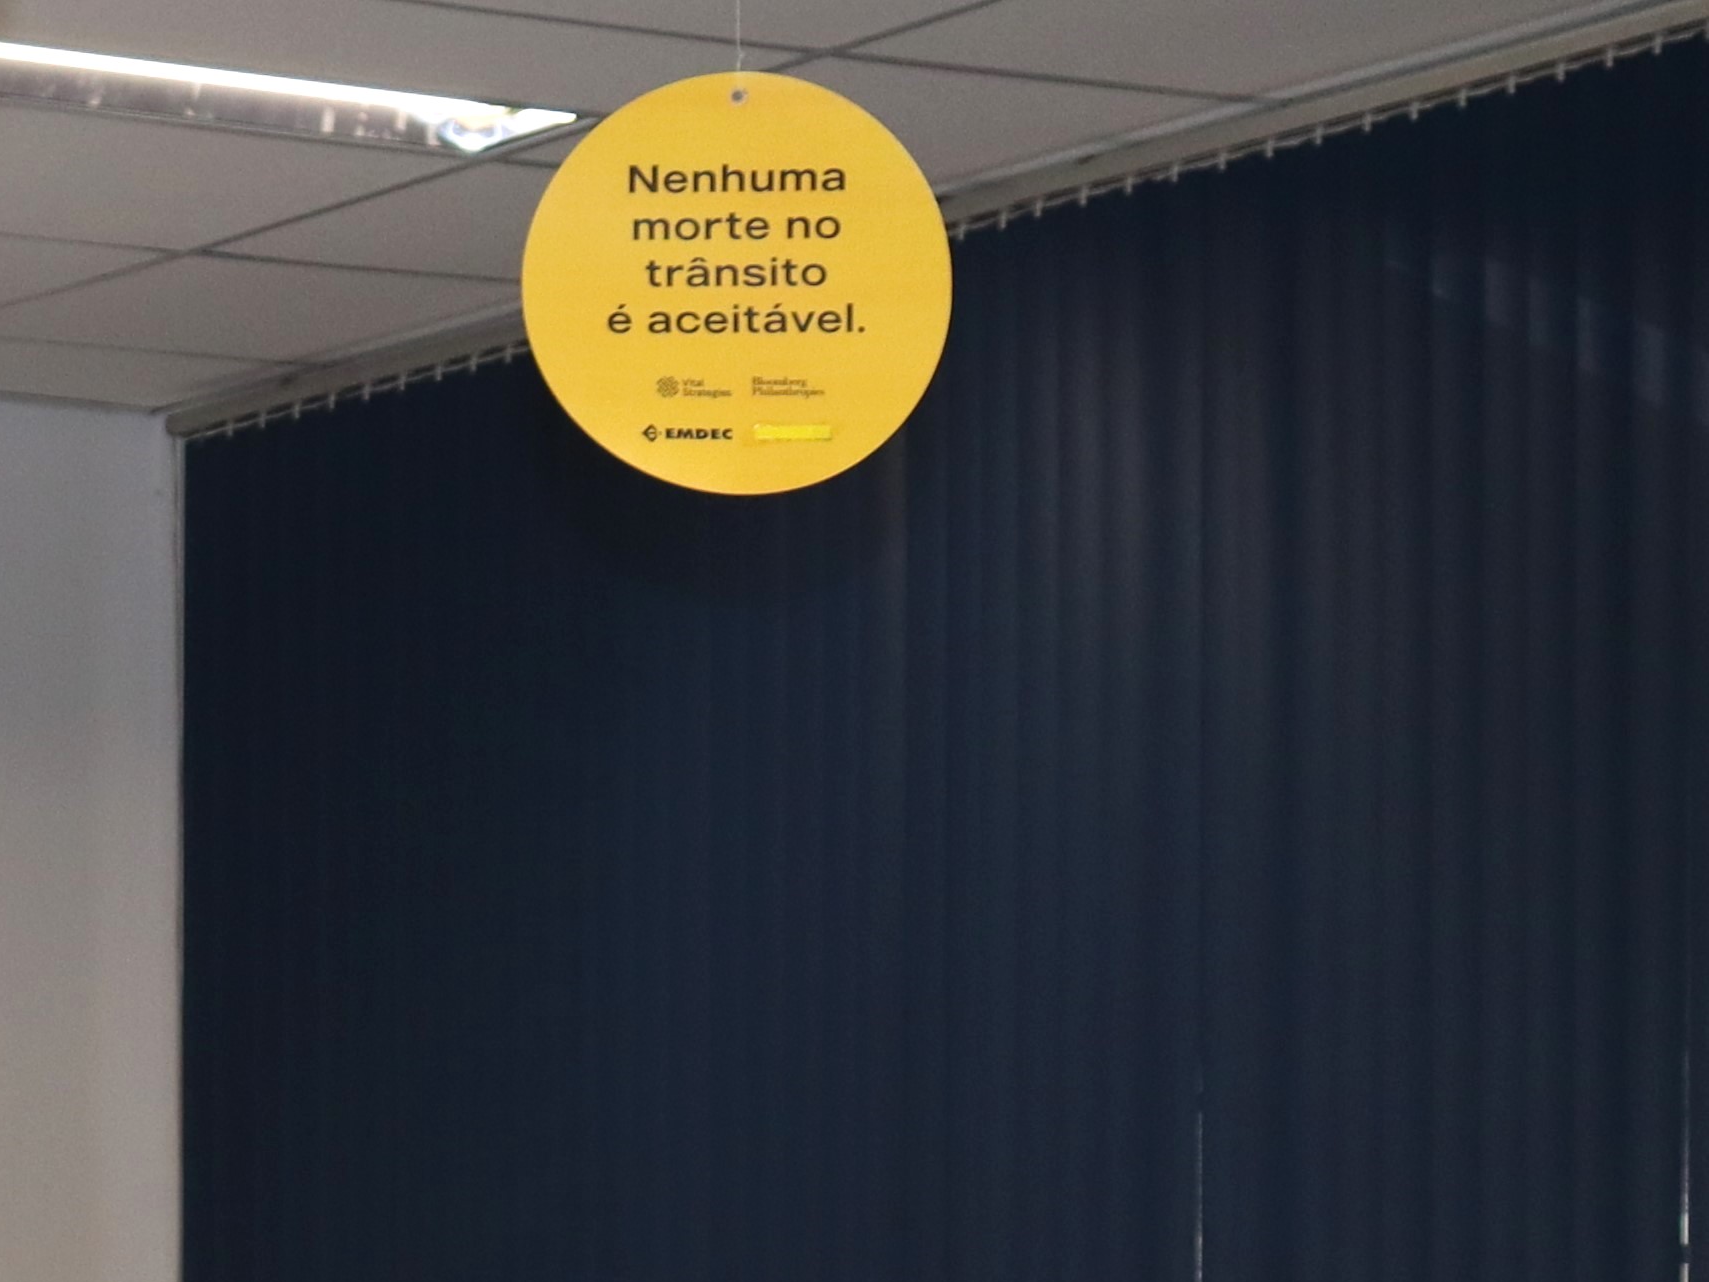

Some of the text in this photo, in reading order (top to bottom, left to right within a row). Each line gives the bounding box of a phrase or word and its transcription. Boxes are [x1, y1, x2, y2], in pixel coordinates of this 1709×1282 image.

[629, 164, 846, 194] Nenhuma
[633, 212, 841, 241] morte no
[645, 257, 827, 288] trânsito
[607, 303, 865, 334] é aceitável.
[665, 428, 733, 440] EMDEC
